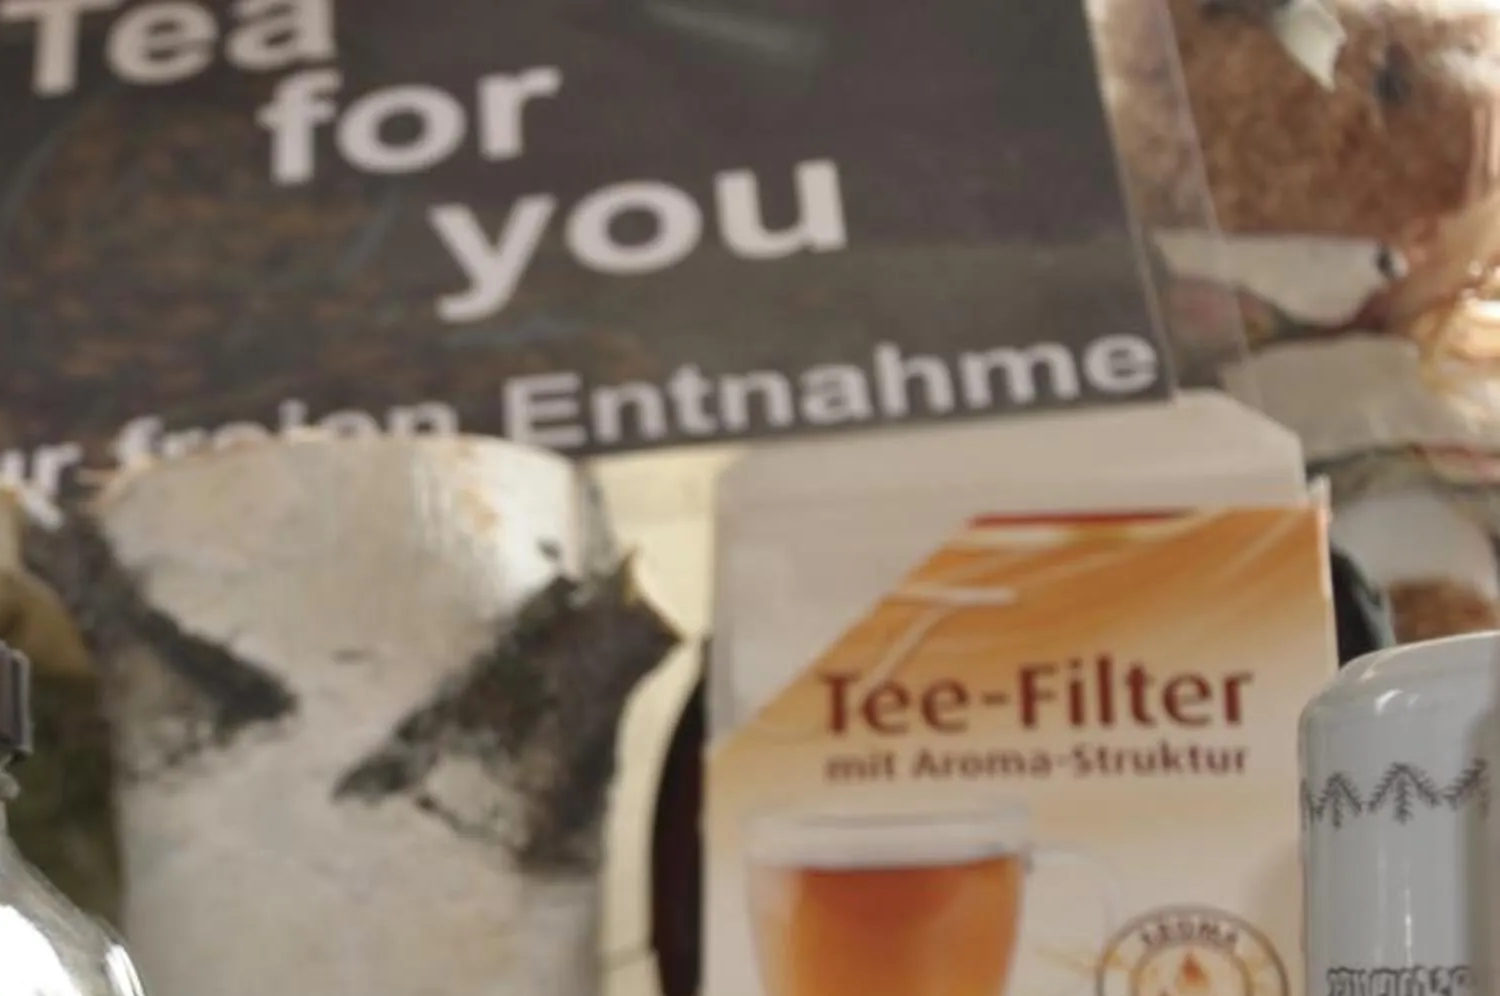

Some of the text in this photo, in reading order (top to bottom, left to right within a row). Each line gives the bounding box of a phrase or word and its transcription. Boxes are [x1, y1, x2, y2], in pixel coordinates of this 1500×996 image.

[256, 67, 561, 185] for
[429, 159, 848, 323] you
[502, 331, 1160, 450] Entnahme
[818, 652, 1254, 738] Tee-Filter
[824, 739, 1249, 783] mit Aroma-Struktur
